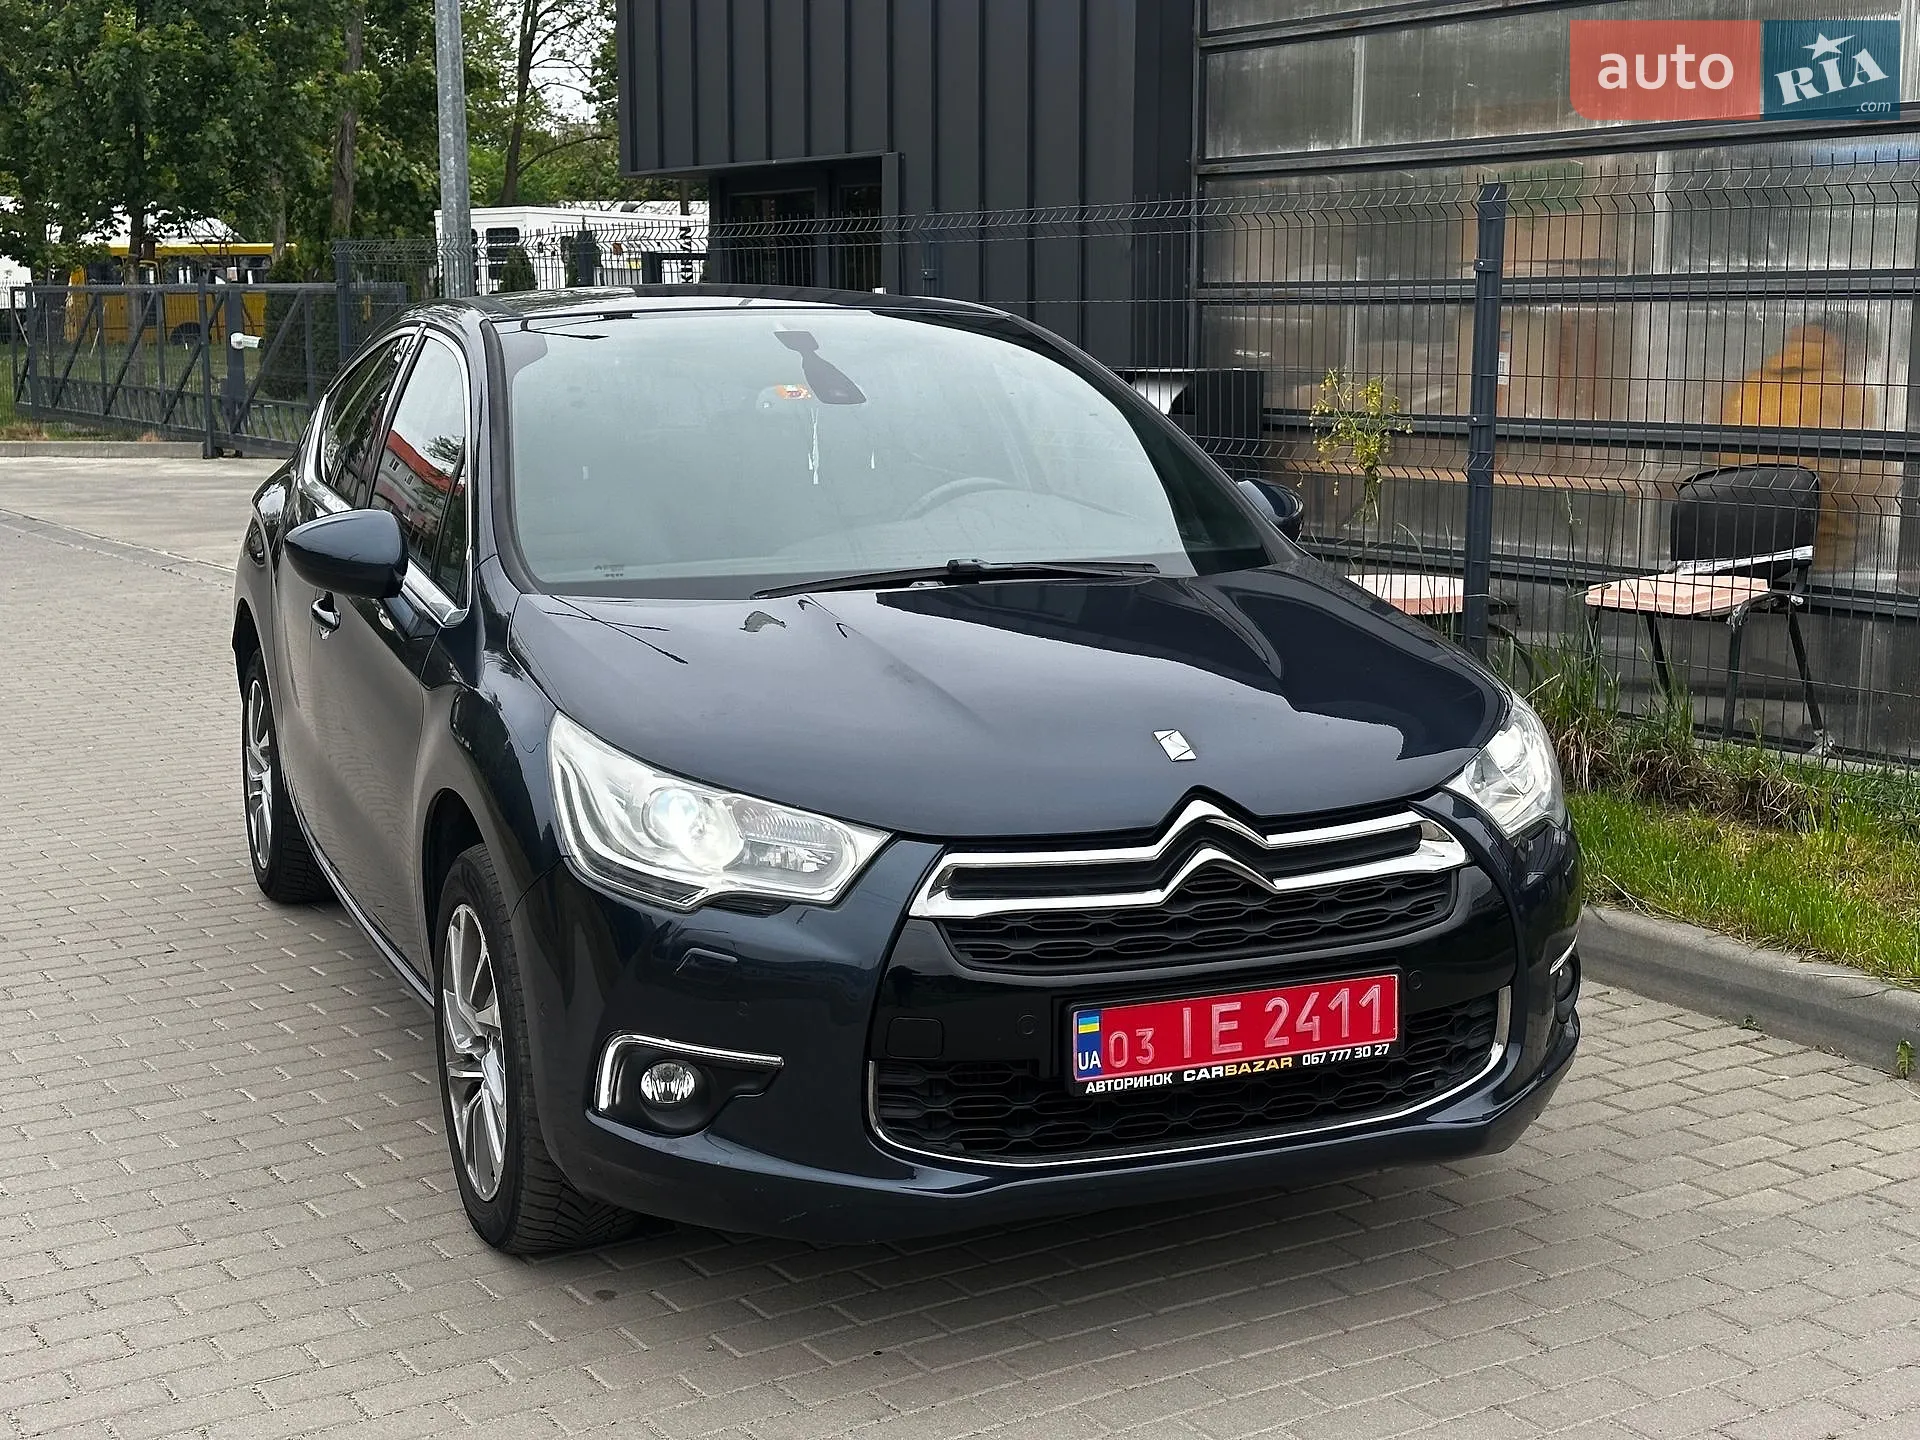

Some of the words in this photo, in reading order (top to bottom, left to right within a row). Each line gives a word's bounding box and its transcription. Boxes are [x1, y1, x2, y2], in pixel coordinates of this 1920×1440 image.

[1108, 1027, 1155, 1068] 03
[1182, 1001, 1243, 1058] IE
[1264, 984, 1381, 1048] 2411
[1078, 1051, 1101, 1070] UA
[1085, 1072, 1173, 1094] АВТОРИНОК
[1183, 1057, 1293, 1082] CARBAZAR
[1302, 1052, 1327, 1066] 067
[1329, 1049, 1351, 1062] 777
[1354, 1045, 1371, 1059] 30
[1374, 1043, 1390, 1056] 27
